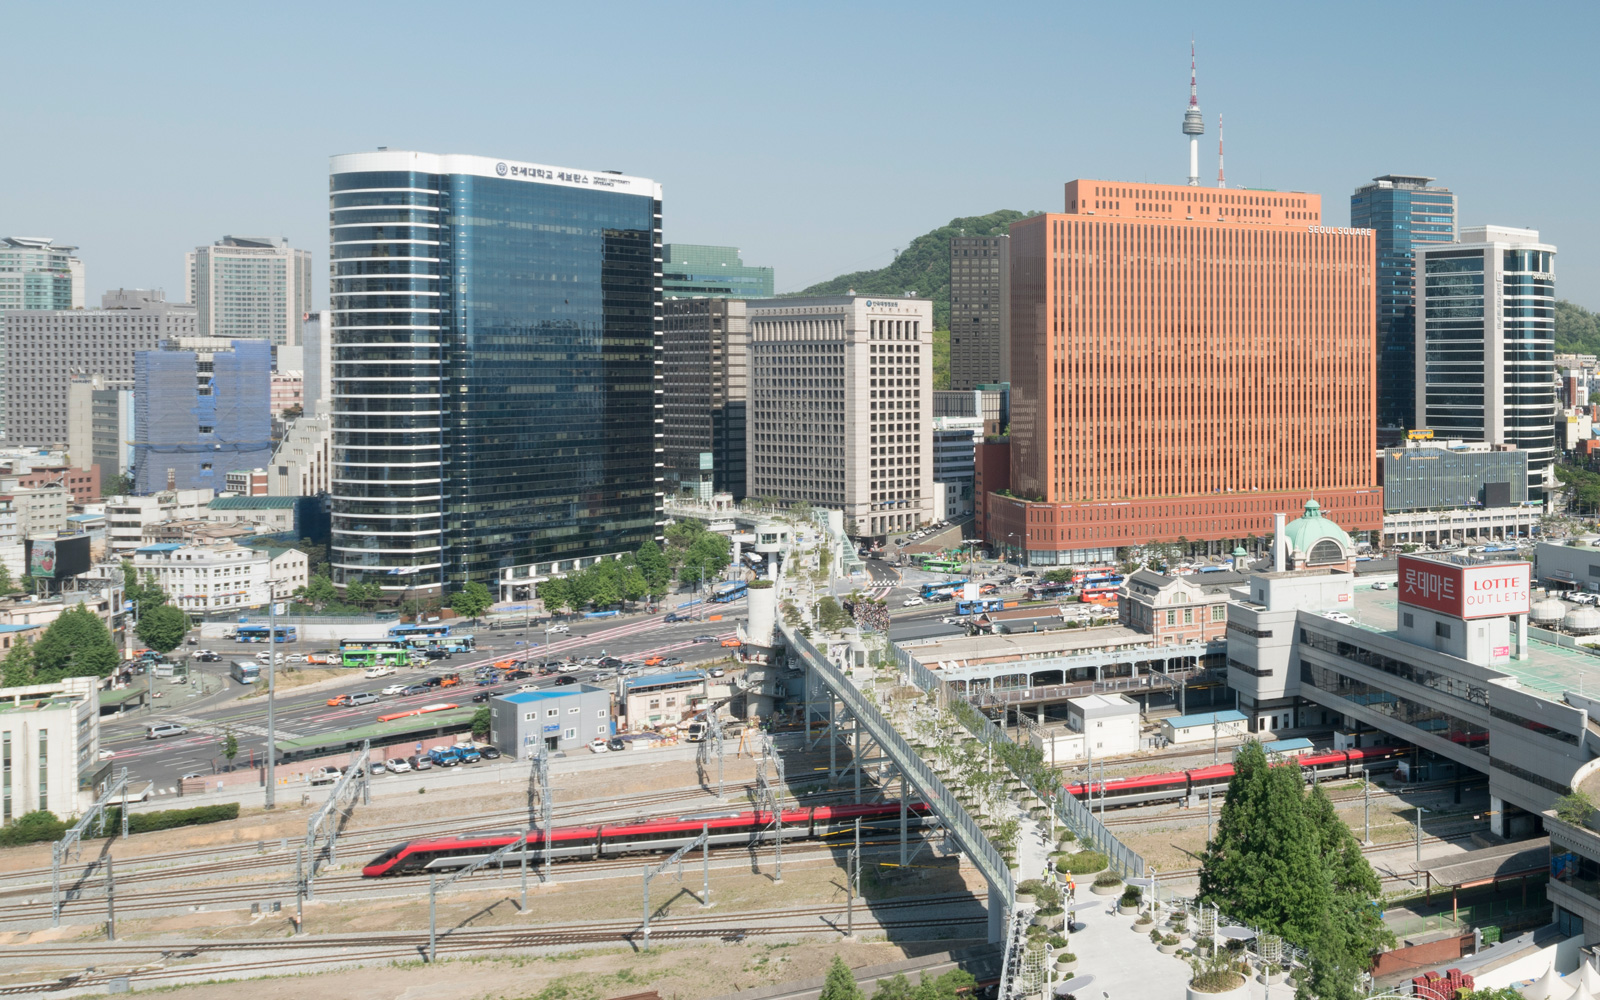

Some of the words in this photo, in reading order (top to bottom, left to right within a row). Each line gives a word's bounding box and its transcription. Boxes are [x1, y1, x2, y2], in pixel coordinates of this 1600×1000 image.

[510, 166, 553, 180] 연세대학교
[557, 172, 589, 184] 세브란스
[1308, 225, 1337, 235] SEOUL
[1338, 227, 1371, 236] SQUARE
[1405, 568, 1455, 601] 롯데마트
[1474, 577, 1520, 591] LOTTE
[1467, 591, 1527, 605] OUTLETS
